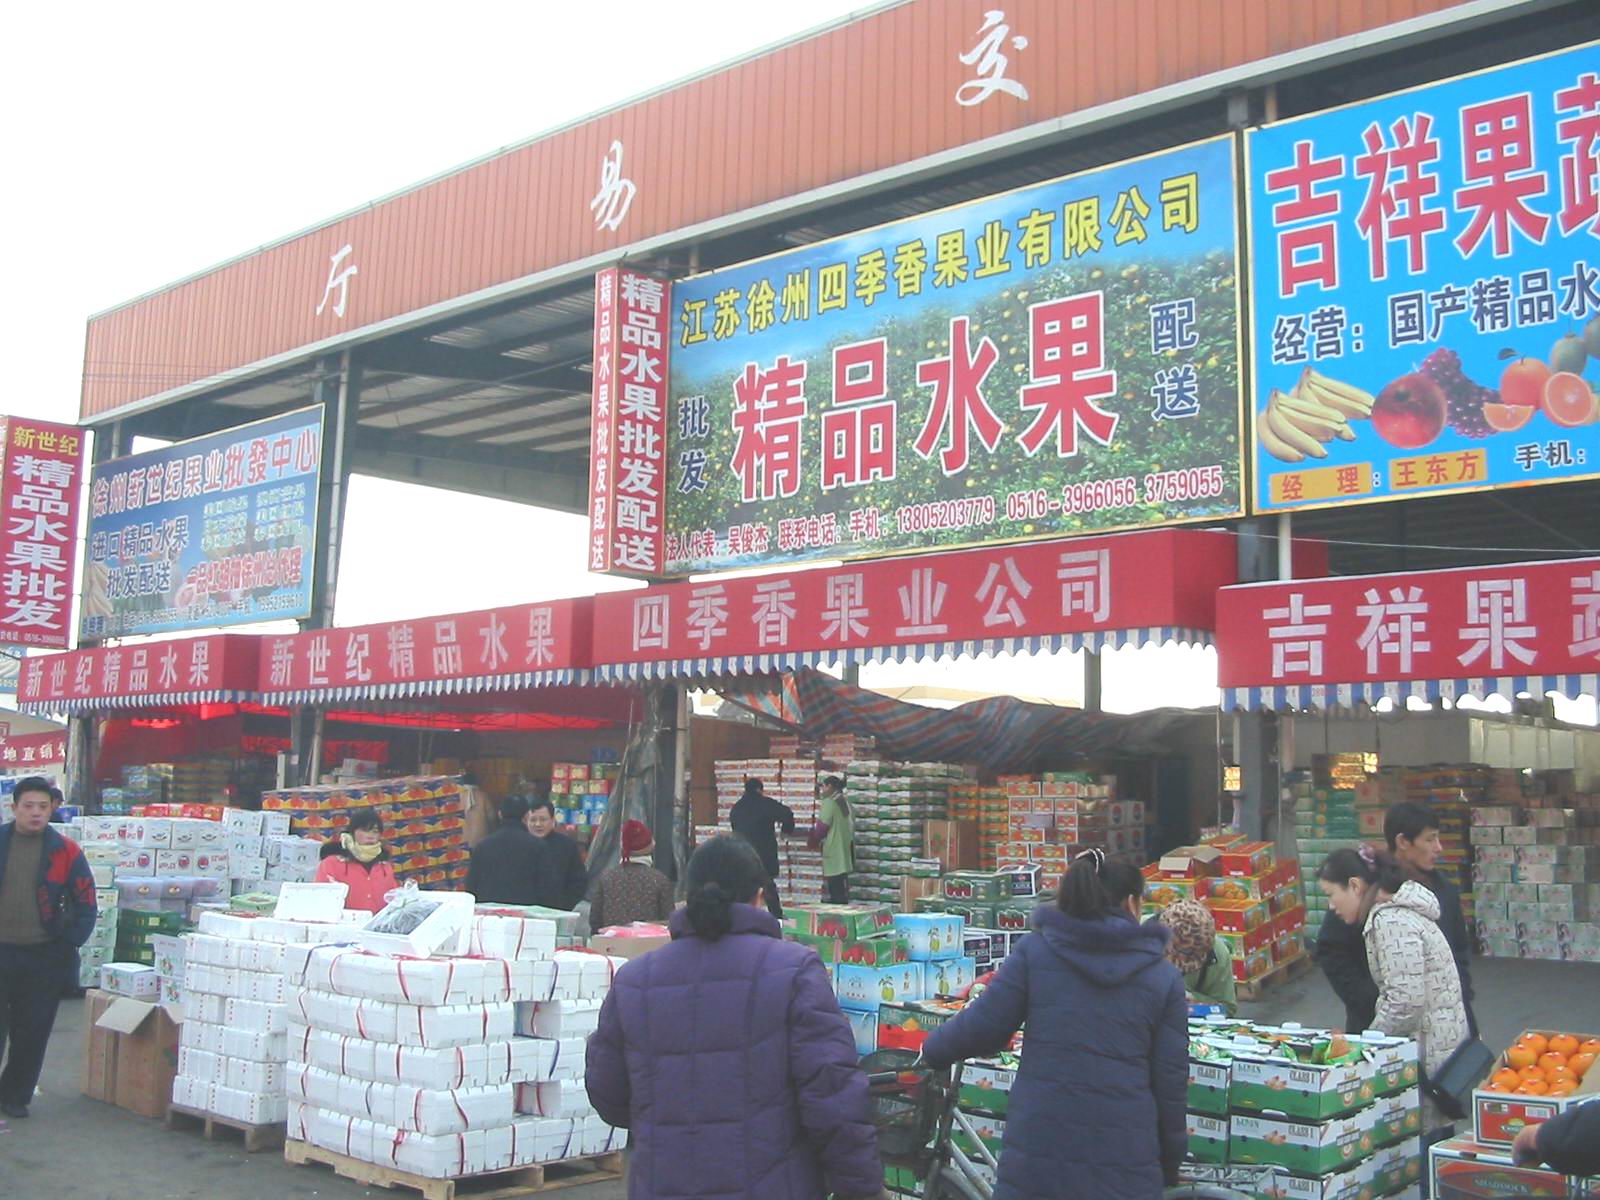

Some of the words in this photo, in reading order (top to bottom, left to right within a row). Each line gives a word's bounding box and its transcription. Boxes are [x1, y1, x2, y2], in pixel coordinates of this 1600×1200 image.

[955, 11, 1030, 106] 交
[590, 140, 637, 232] 易
[317, 245, 357, 317] 厅
[680, 173, 1200, 347] 江苏徐州四季香果业有限公司
[730, 289, 1120, 504] 精品水果
[1150, 298, 1200, 422] 配送
[14, 426, 79, 456] 新世纪
[591, 274, 612, 570] 精品水果批发配送
[613, 274, 664, 572] 精品水果批发配送
[678, 395, 709, 495] 批发
[728, 524, 769, 556] 吴俊杰
[896, 495, 994, 535] 13805203779
[1006, 476, 1136, 521] 0516-3966056
[1144, 464, 1224, 503] 3759055
[1395, 451, 1481, 487] 王东方
[1, 454, 76, 631] 精品水果批发
[92, 514, 188, 563] 进口精品水果
[107, 560, 171, 600] 批发配送
[632, 547, 1112, 651] 四季香果业公司
[25, 640, 210, 698] 新世纪精品水果
[270, 606, 556, 688] 新世纪精品水果
